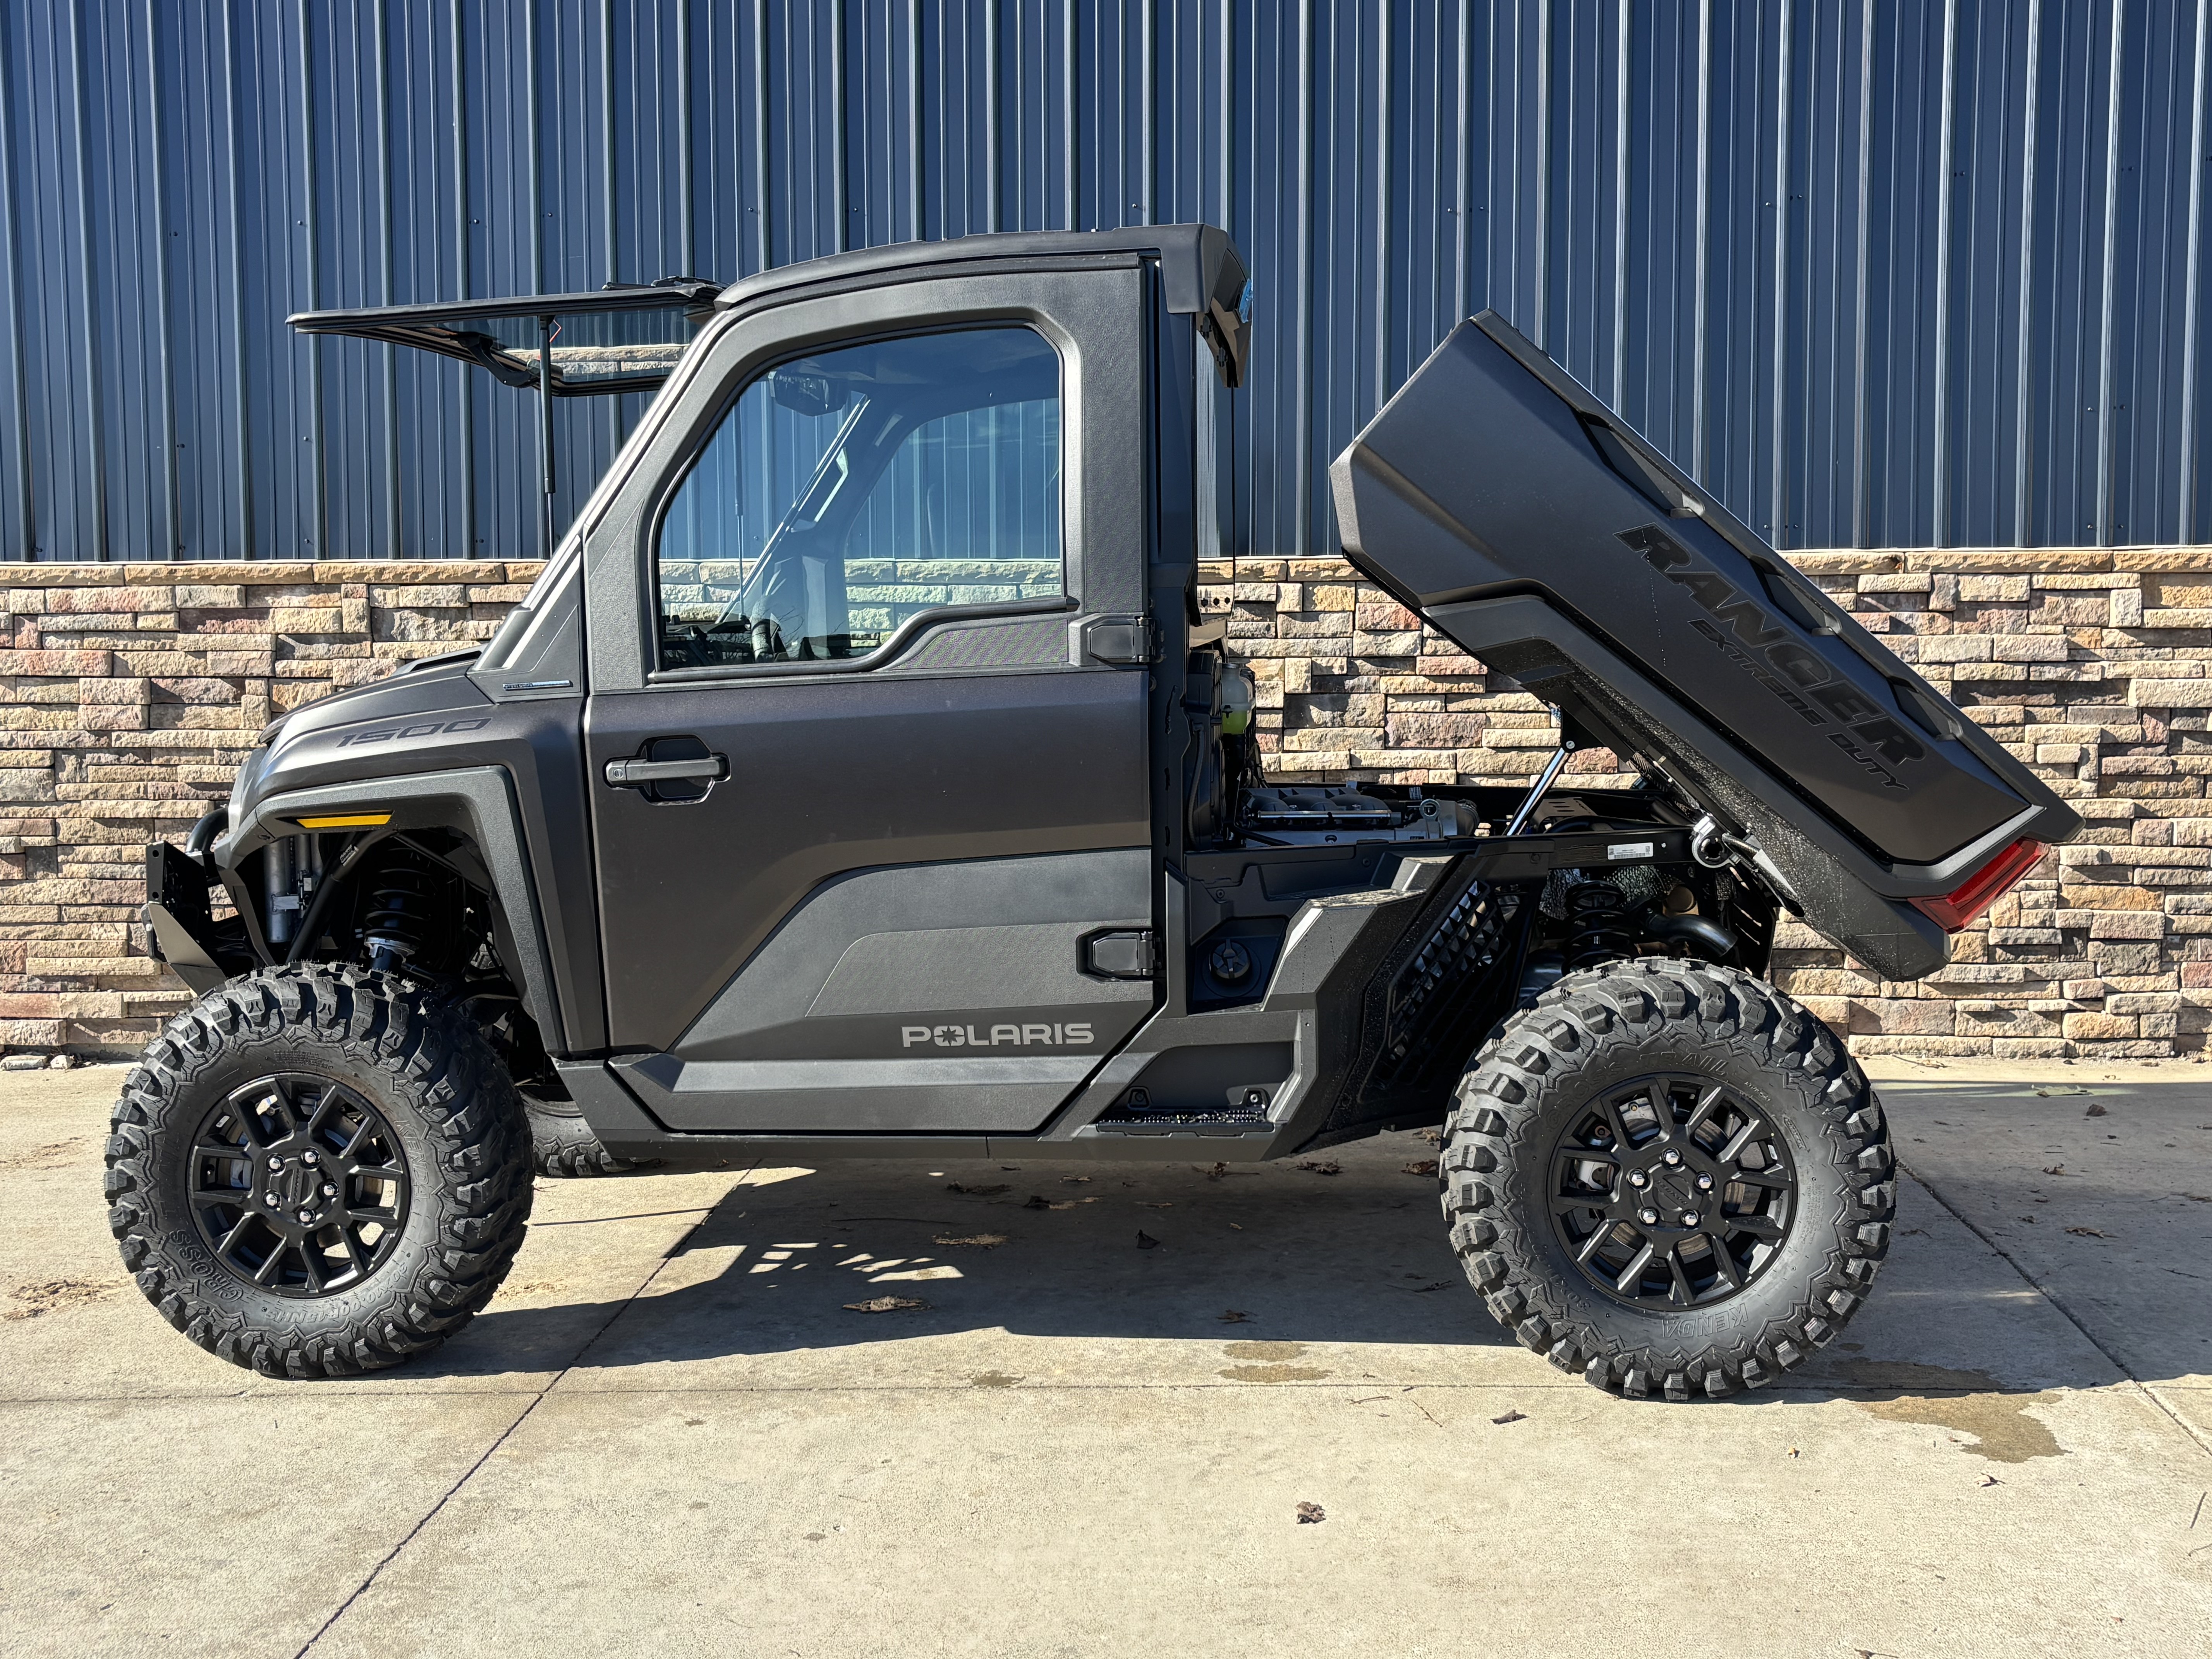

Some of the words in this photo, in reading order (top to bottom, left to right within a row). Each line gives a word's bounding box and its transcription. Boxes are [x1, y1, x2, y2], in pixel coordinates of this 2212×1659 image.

[1613, 522, 1926, 766] RANGER
[336, 717, 492, 748] 1500
[1688, 618, 1828, 726] EXTREME
[1826, 733, 1909, 790] DUTY
[902, 1023, 1095, 1047] POLARIS
[1547, 1062, 1626, 1129] CROSS
[1639, 1051, 1729, 1075] TRAIL
[393, 1120, 430, 1199] KENDA
[169, 1228, 243, 1302] CROSS
[1661, 1302, 1748, 1338] KENDA
